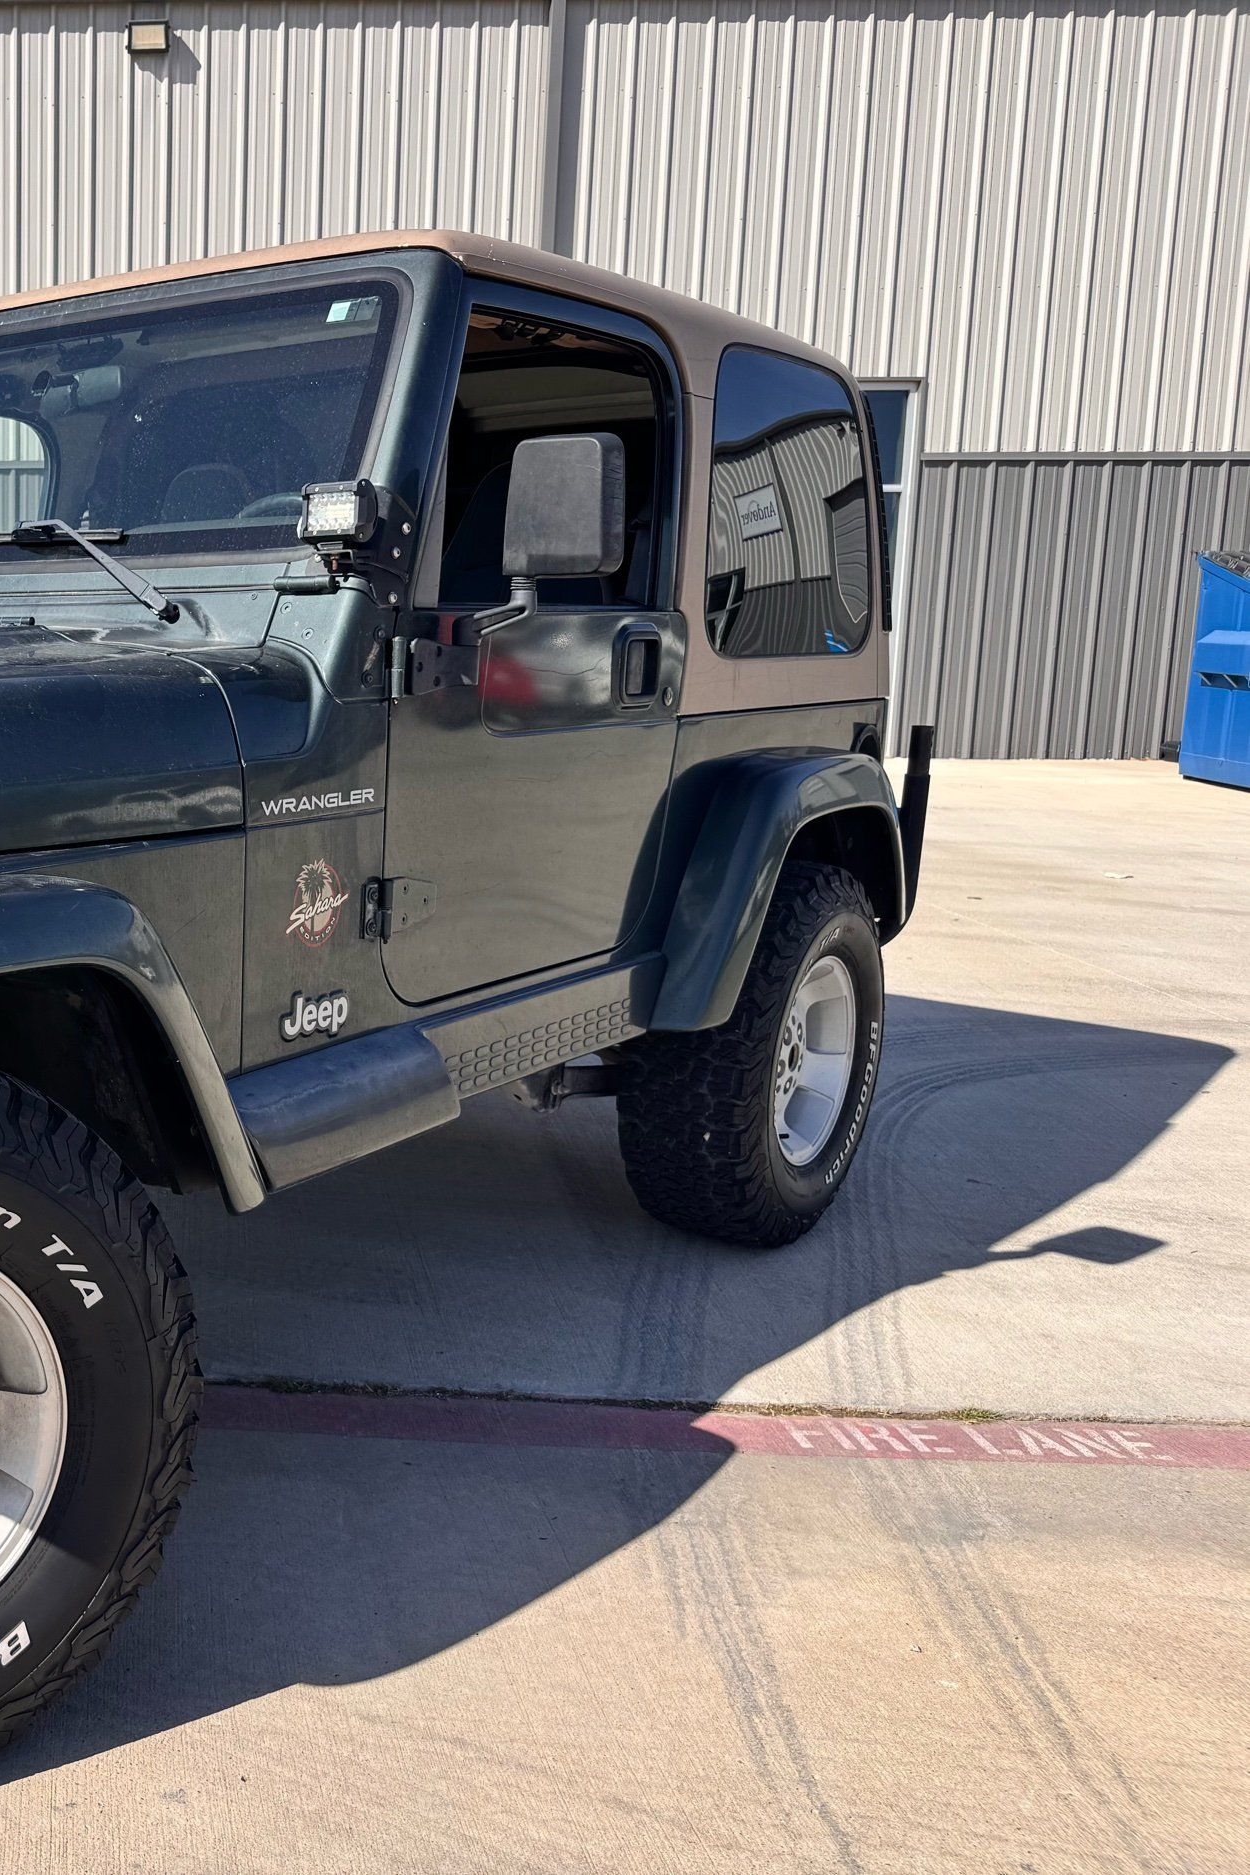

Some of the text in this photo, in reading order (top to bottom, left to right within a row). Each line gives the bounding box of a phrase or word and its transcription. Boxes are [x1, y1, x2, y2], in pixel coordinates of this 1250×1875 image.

[261, 788, 375, 816] WRANGLER
[285, 893, 349, 935] Sahara
[299, 917, 336, 941] EDITION
[284, 996, 348, 1036] Jeep
[824, 1021, 879, 1184] BFGoodrich
[41, 1234, 104, 1309] T/A
[787, 1418, 1174, 1461] FIRE LANE
